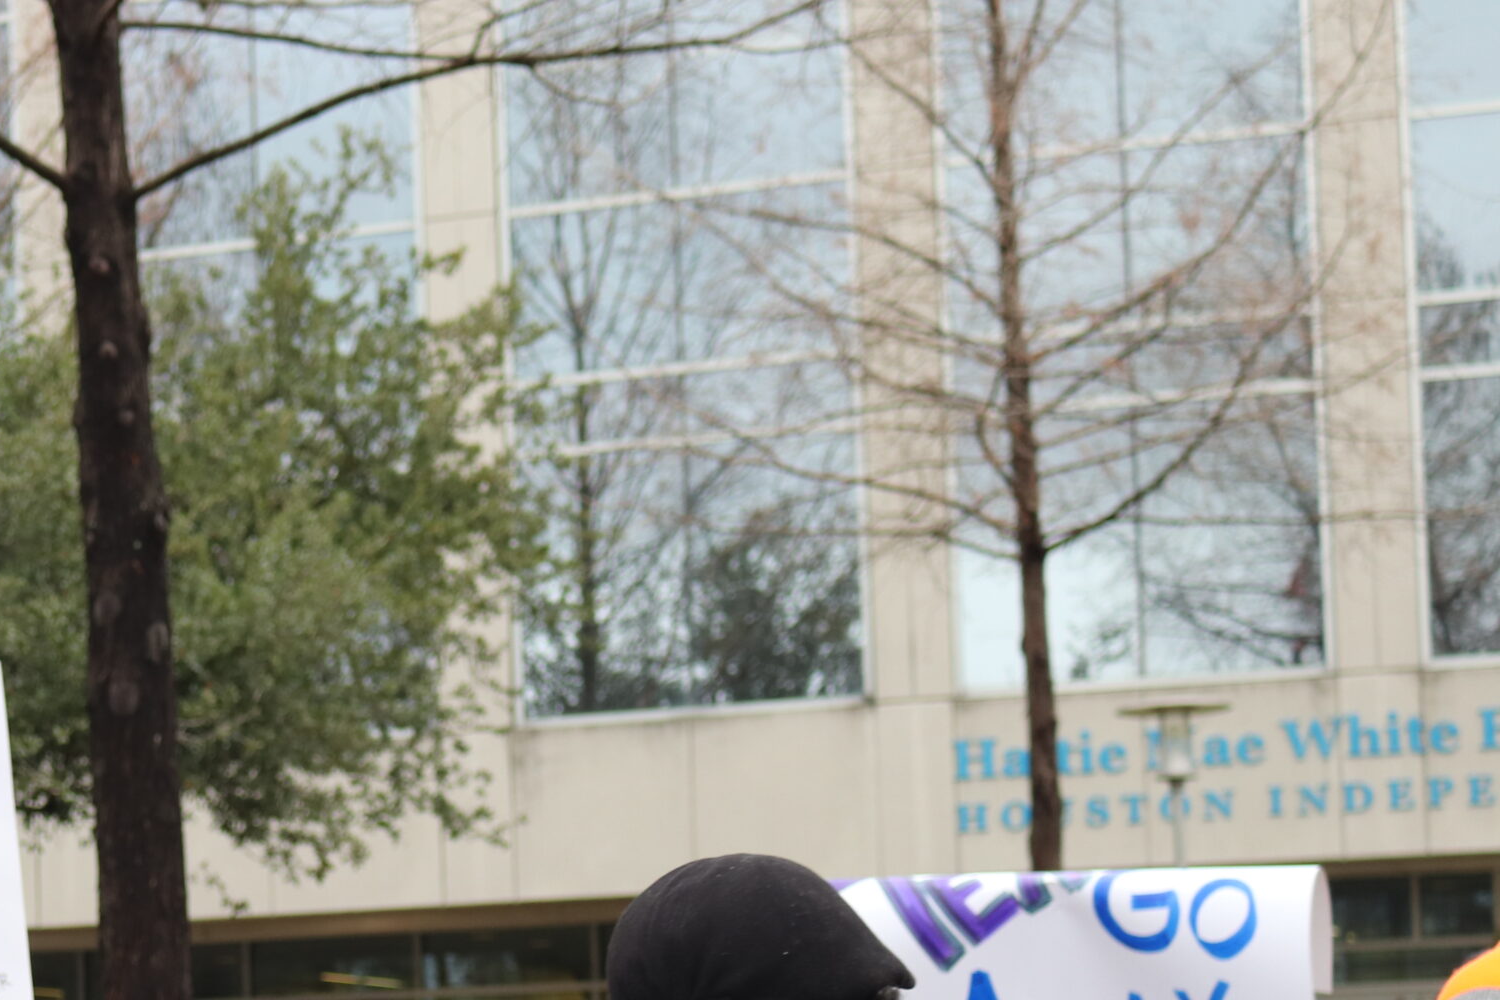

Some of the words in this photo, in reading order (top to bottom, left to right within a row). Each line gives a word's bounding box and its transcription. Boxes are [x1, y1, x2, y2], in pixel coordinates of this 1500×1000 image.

[955, 728, 1126, 781] Hatie
[1147, 724, 1265, 772] ae
[1280, 710, 1460, 761] White
[957, 787, 1235, 834] HOSTON
[1269, 773, 1496, 818] INDEPE
[1093, 871, 1257, 960] GO
